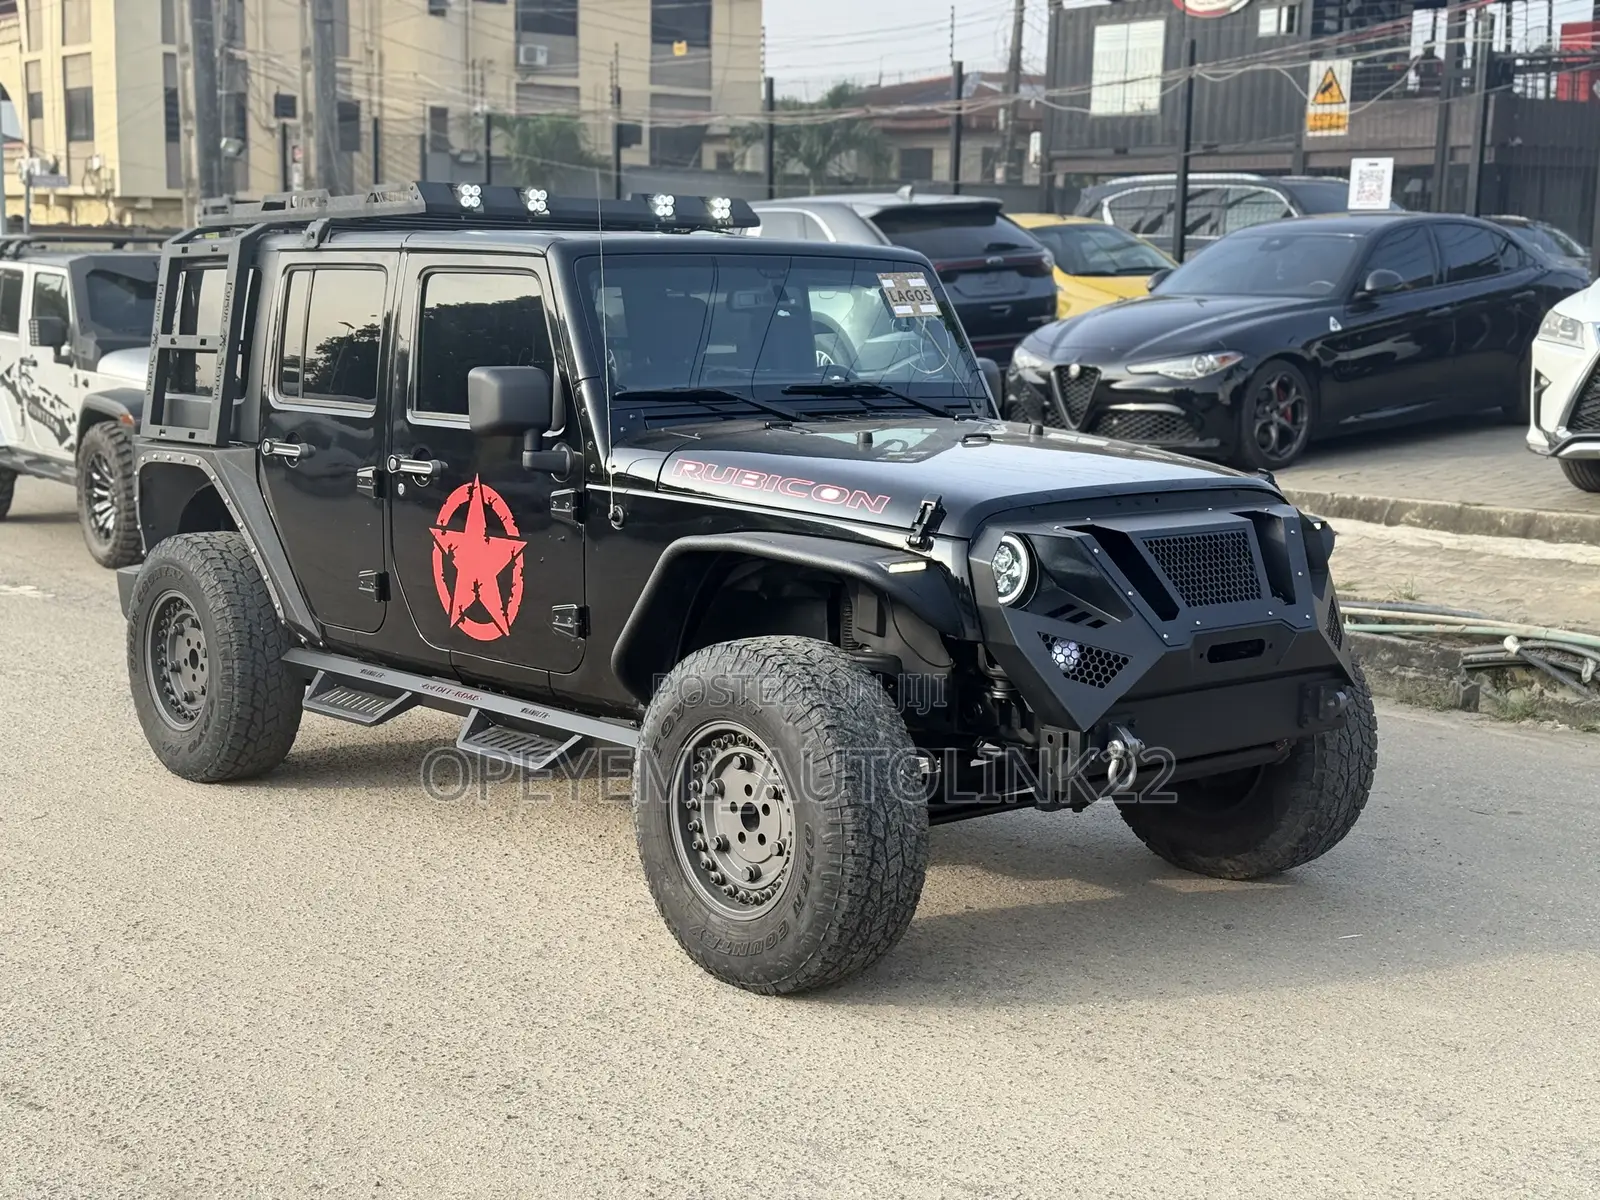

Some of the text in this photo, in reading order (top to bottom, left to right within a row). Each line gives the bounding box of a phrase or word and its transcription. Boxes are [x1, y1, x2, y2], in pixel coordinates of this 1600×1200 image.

[888, 289, 932, 303] LAGOS
[672, 458, 891, 514] RUBICON
[651, 688, 704, 760] TOYO
[688, 821, 816, 958] OPEN COUNTRY
